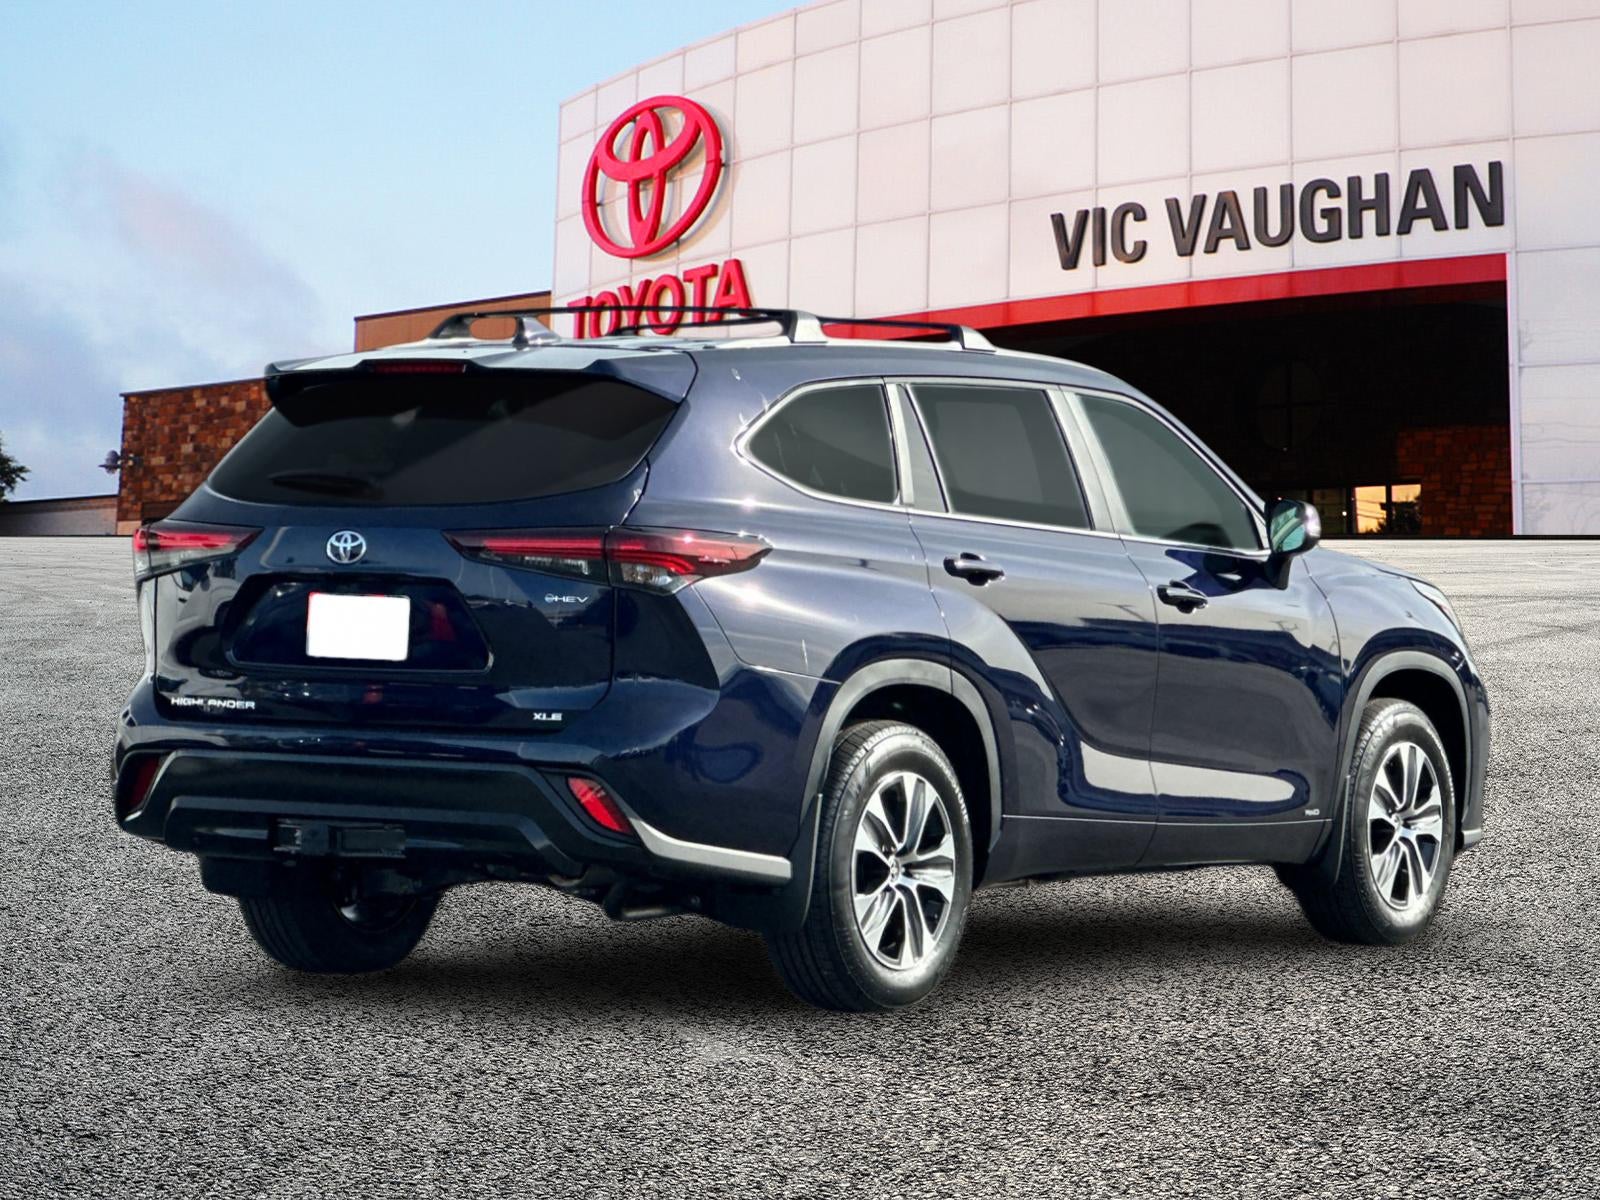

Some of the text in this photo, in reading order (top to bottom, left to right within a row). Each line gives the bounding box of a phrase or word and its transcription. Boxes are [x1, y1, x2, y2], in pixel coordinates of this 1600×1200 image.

[1050, 160, 1505, 270] VIC VAUGHAN
[567, 258, 753, 339] TOYOTA
[533, 712, 563, 721] XLE
